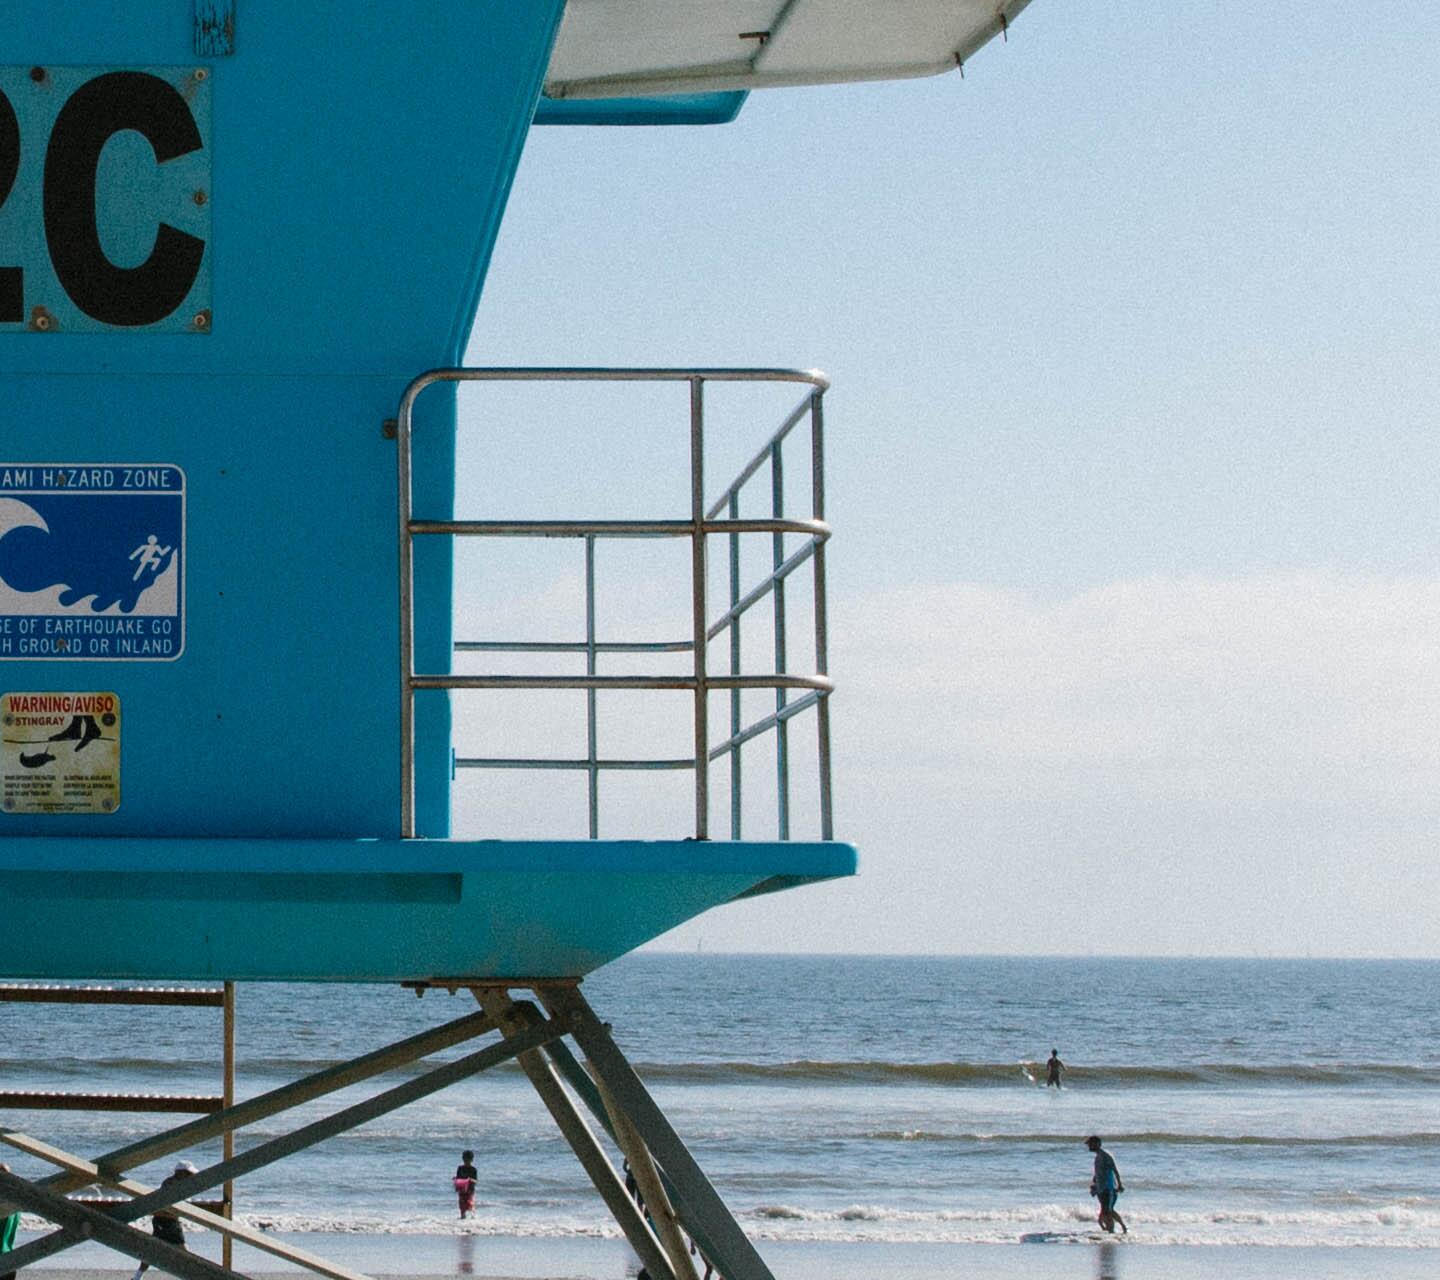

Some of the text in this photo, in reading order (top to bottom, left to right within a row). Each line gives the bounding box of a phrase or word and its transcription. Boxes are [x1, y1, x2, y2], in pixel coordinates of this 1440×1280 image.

[123, 470, 171, 487] ZONE
[19, 619, 38, 634] OF
[45, 619, 144, 634] EARTHQUAKE
[151, 619, 172, 634] GO
[19, 638, 82, 654] GROUND
[89, 638, 109, 654] OR
[116, 638, 173, 654] INLAND
[9, 696, 113, 712] WARNING/AVISO
[15, 716, 65, 726] STINGRAY
